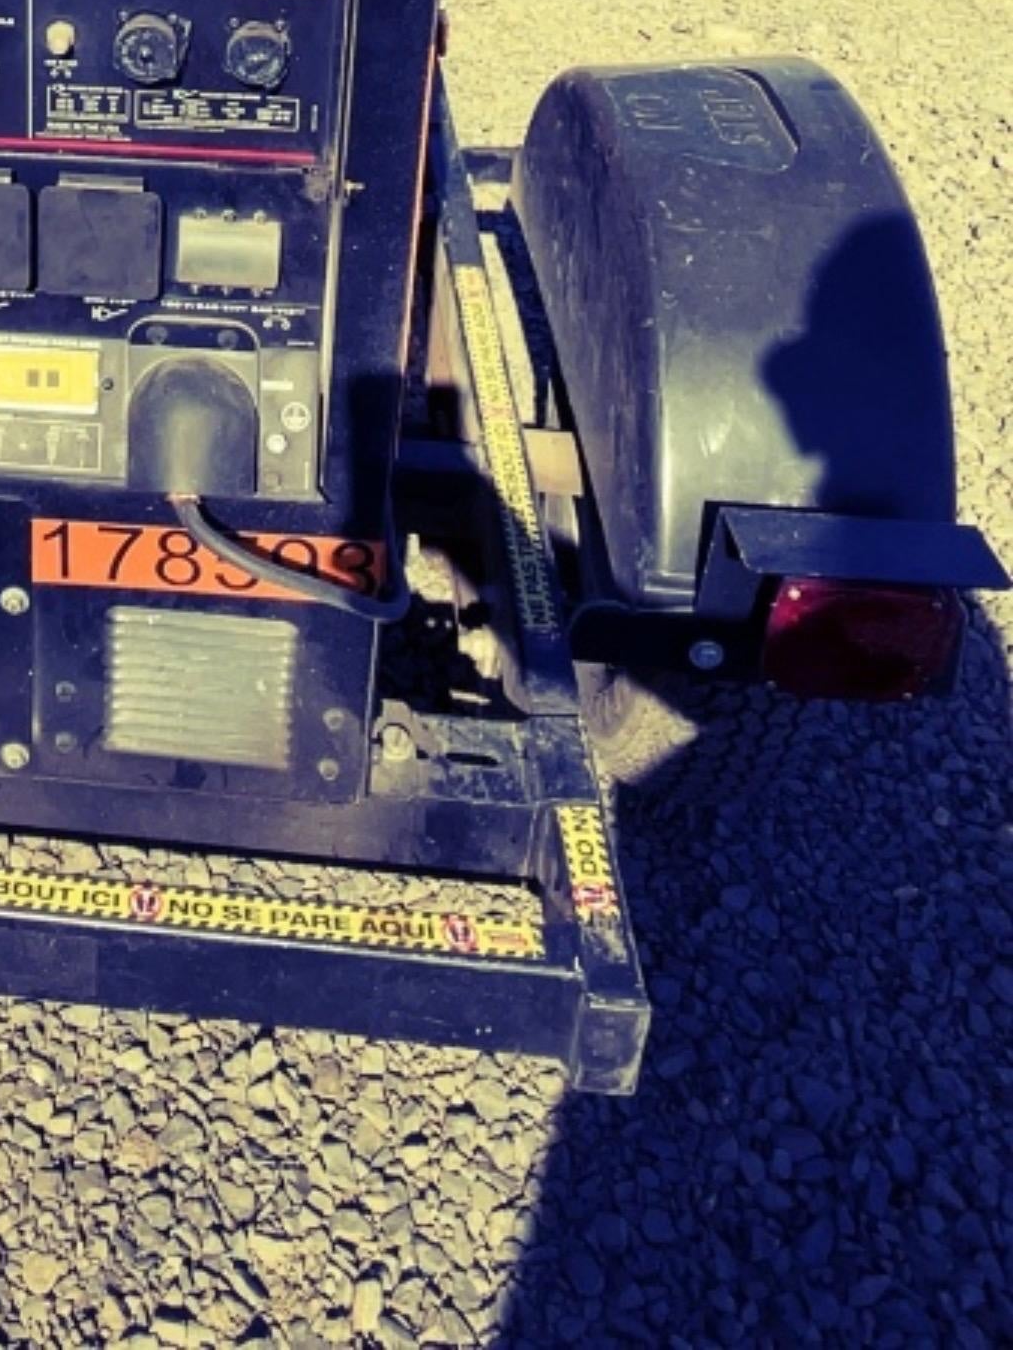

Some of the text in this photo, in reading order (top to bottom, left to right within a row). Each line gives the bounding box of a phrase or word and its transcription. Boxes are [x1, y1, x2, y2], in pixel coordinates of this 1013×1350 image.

[81, 890, 120, 908] ICI
[168, 899, 214, 918] NO
[222, 904, 261, 924] SE
[270, 908, 352, 932] PARE
